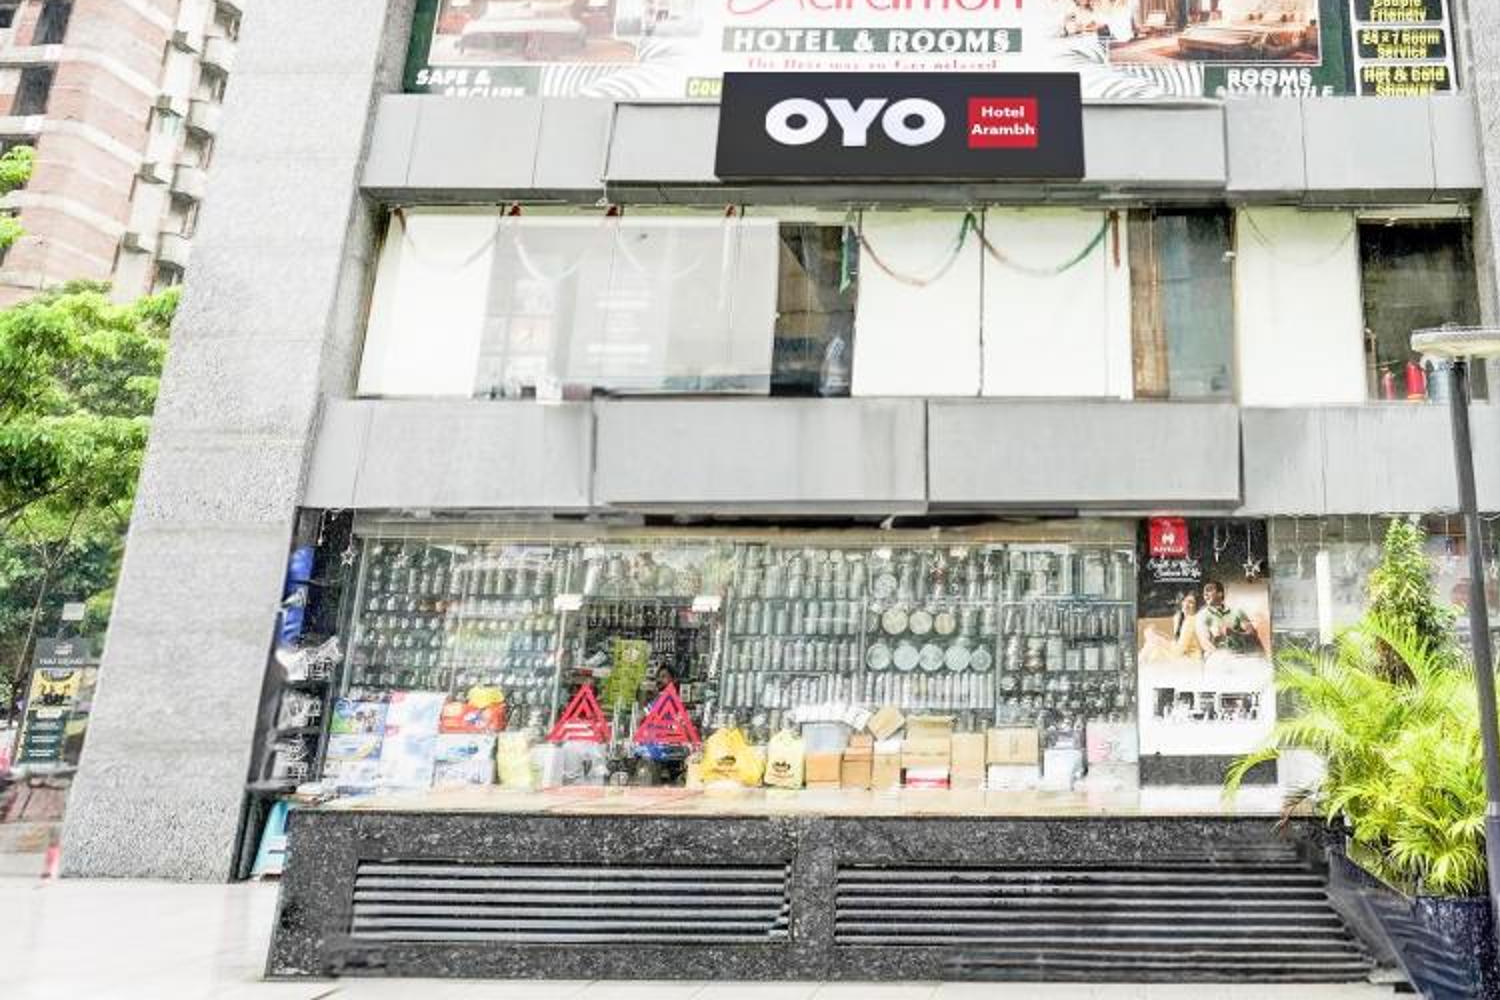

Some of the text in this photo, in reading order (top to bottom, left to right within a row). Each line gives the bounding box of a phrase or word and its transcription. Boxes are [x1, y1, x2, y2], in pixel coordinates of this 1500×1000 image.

[1370, 7, 1427, 23] Friendly
[733, 29, 1011, 53] HOTEL & ROOMS
[1401, 29, 1441, 45] Room
[1377, 44, 1428, 60] Service
[1226, 67, 1312, 88] ROOMS
[981, 105, 1026, 118] Hotel
[765, 97, 946, 146] OYO
[971, 123, 1036, 136] Arambh
